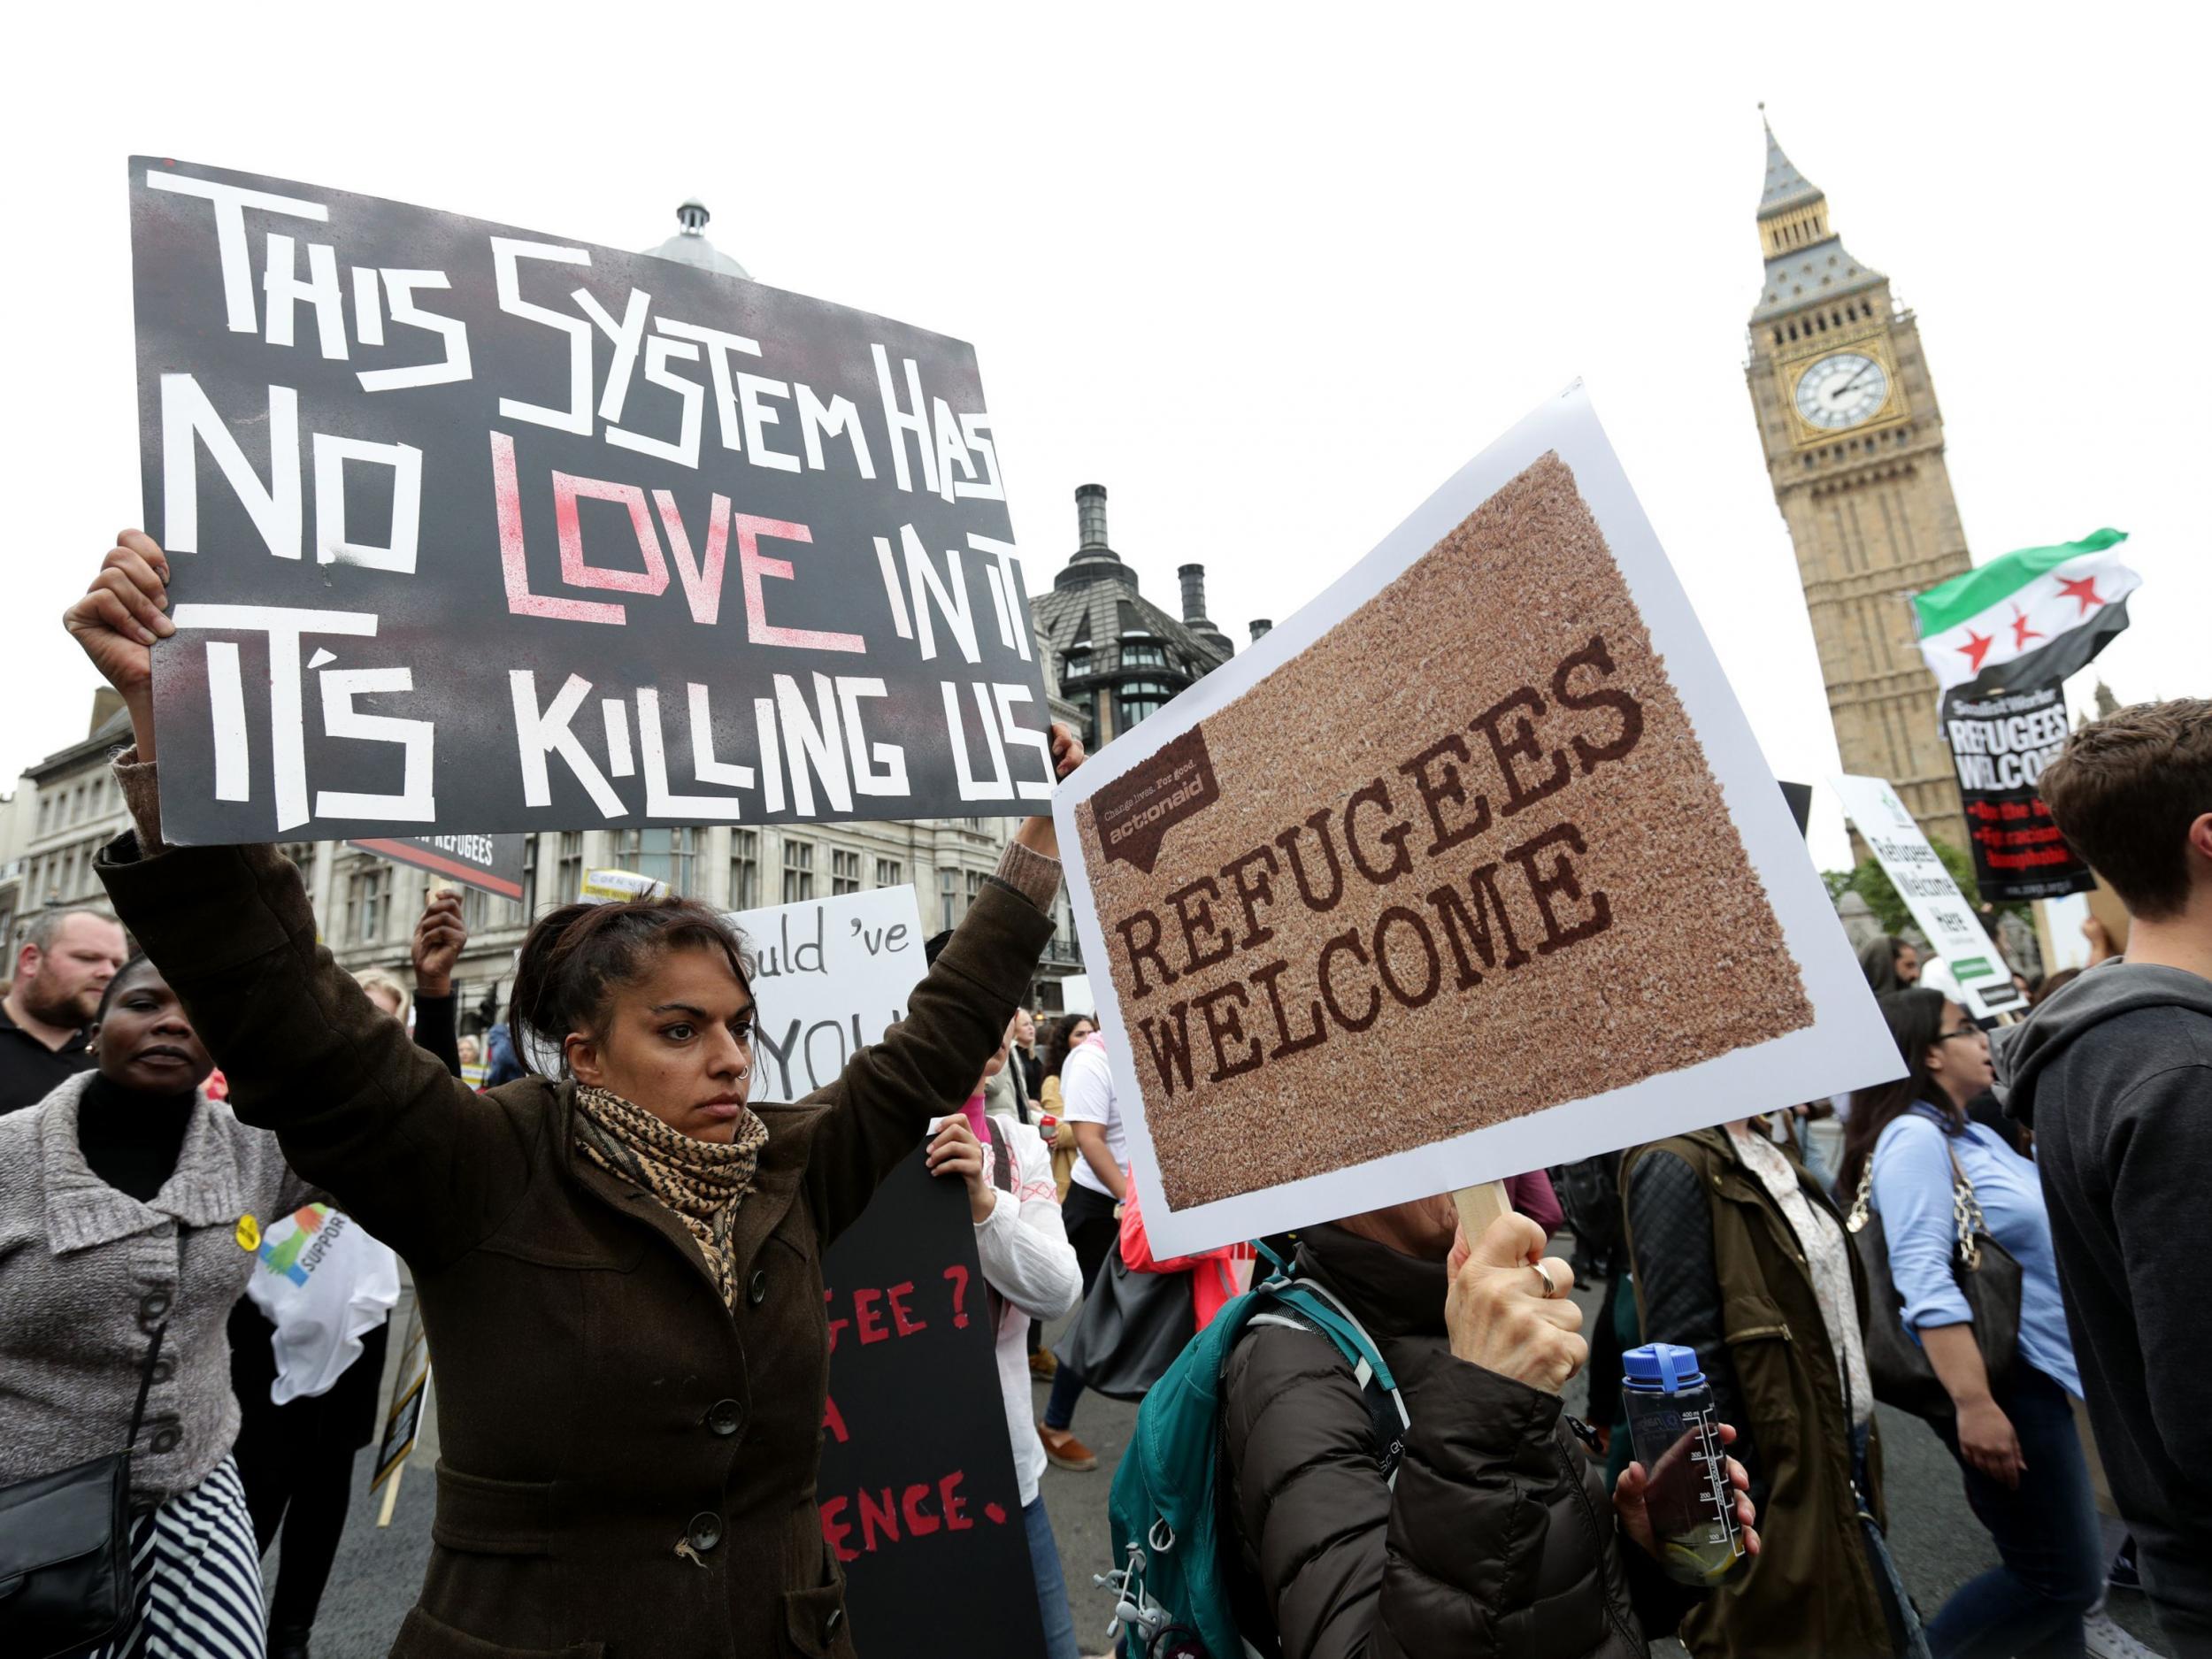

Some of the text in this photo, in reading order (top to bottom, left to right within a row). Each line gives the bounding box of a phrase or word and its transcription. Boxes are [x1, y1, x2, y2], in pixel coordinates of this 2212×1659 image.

[147, 170, 1006, 505] THIS SYSTEM HAS
[160, 373, 1033, 664] NO LOVE IN IT
[173, 603, 1057, 833] IT'S KILLING US
[1947, 703, 2069, 756] REFUGEES
[1104, 798, 1134, 822] Change
[1155, 775, 1173, 790] For
[1173, 759, 1197, 780] good.
[1955, 741, 2065, 791] WELCO
[1116, 635, 1645, 1001] REFUGEES
[850, 918, 910, 956] 've
[1138, 821, 1613, 1098] WELCOME
[301, 1211, 347, 1272] SUPPOR
[943, 1264, 970, 1329] ?
